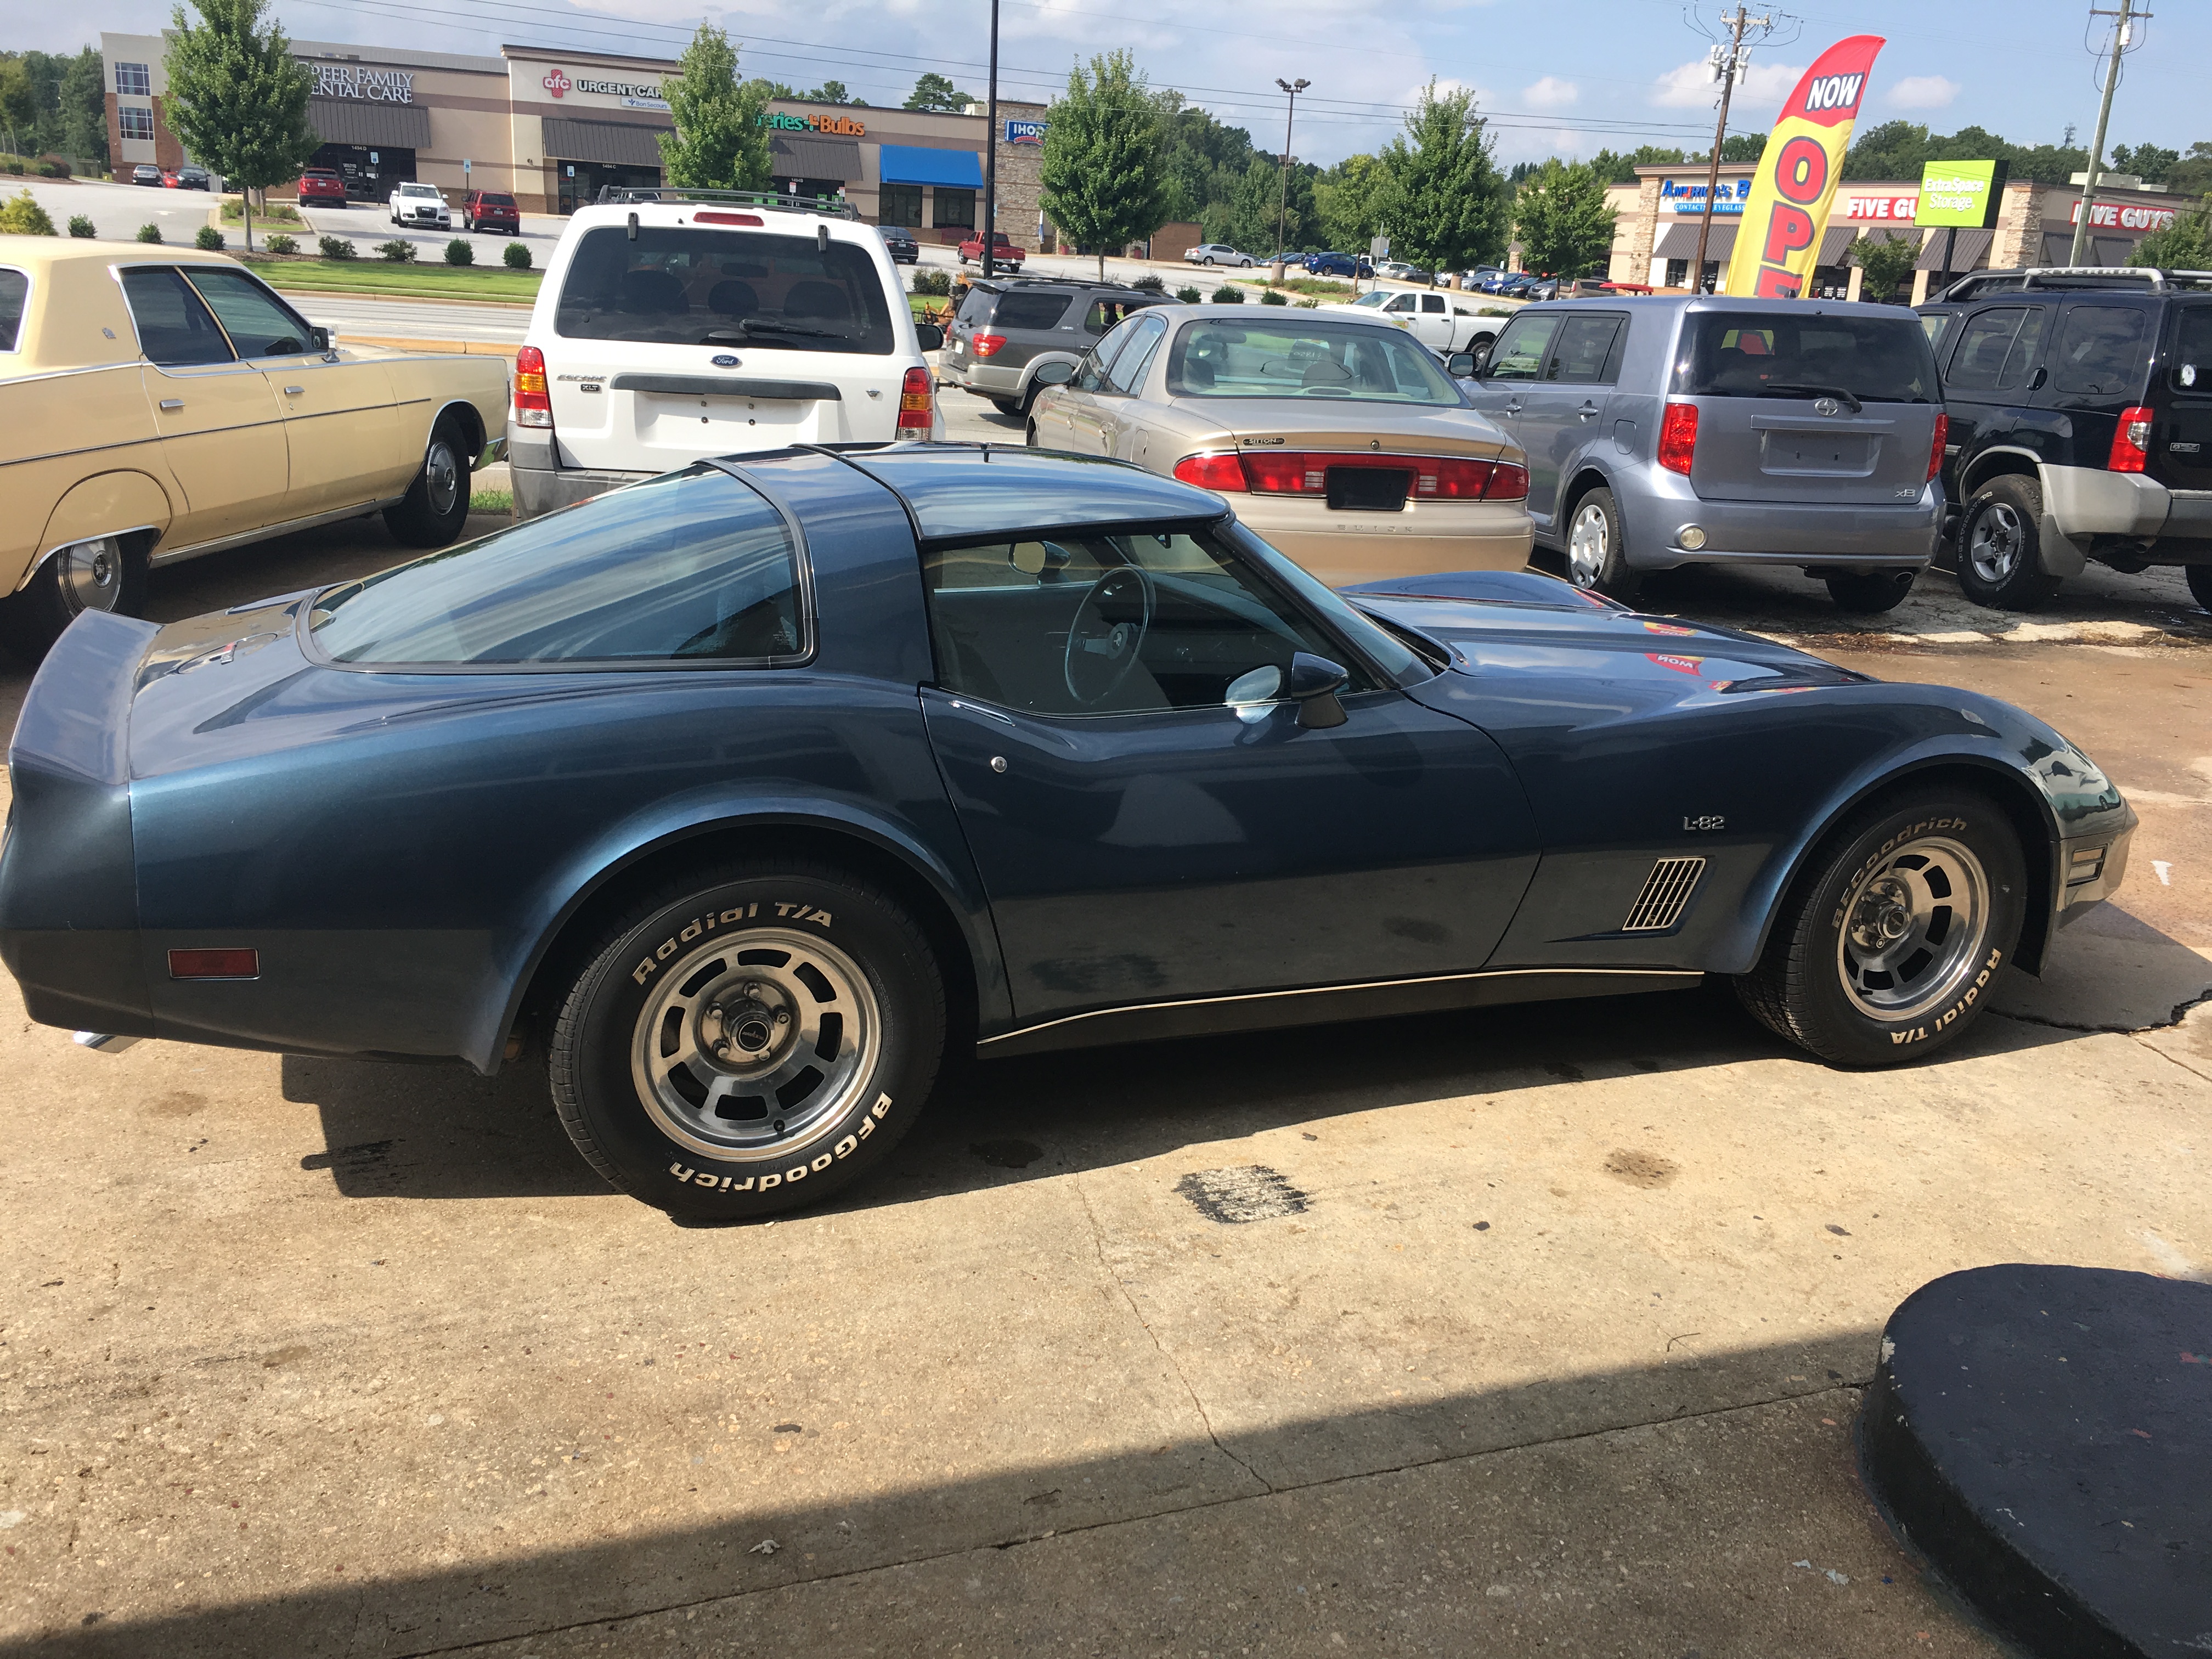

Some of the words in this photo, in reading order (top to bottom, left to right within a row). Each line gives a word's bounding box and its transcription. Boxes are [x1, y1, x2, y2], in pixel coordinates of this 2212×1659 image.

[297, 61, 353, 83] REER
[367, 84, 413, 104] CARE
[544, 75, 569, 89] afc
[577, 80, 635, 96] URGENT
[1806, 75, 1862, 110] NOW
[820, 115, 865, 136] Bulbs
[1754, 136, 1829, 298] OPE
[1847, 199, 1890, 218] FIVE
[1894, 489, 1916, 497] xB
[1683, 815, 1725, 831] L-82
[631, 902, 759, 985] Radial
[774, 901, 833, 927] T/A
[1936, 947, 2002, 1032] Radial
[1890, 1026, 1928, 1045] T/A
[669, 1091, 893, 1193] BFGoodrich
